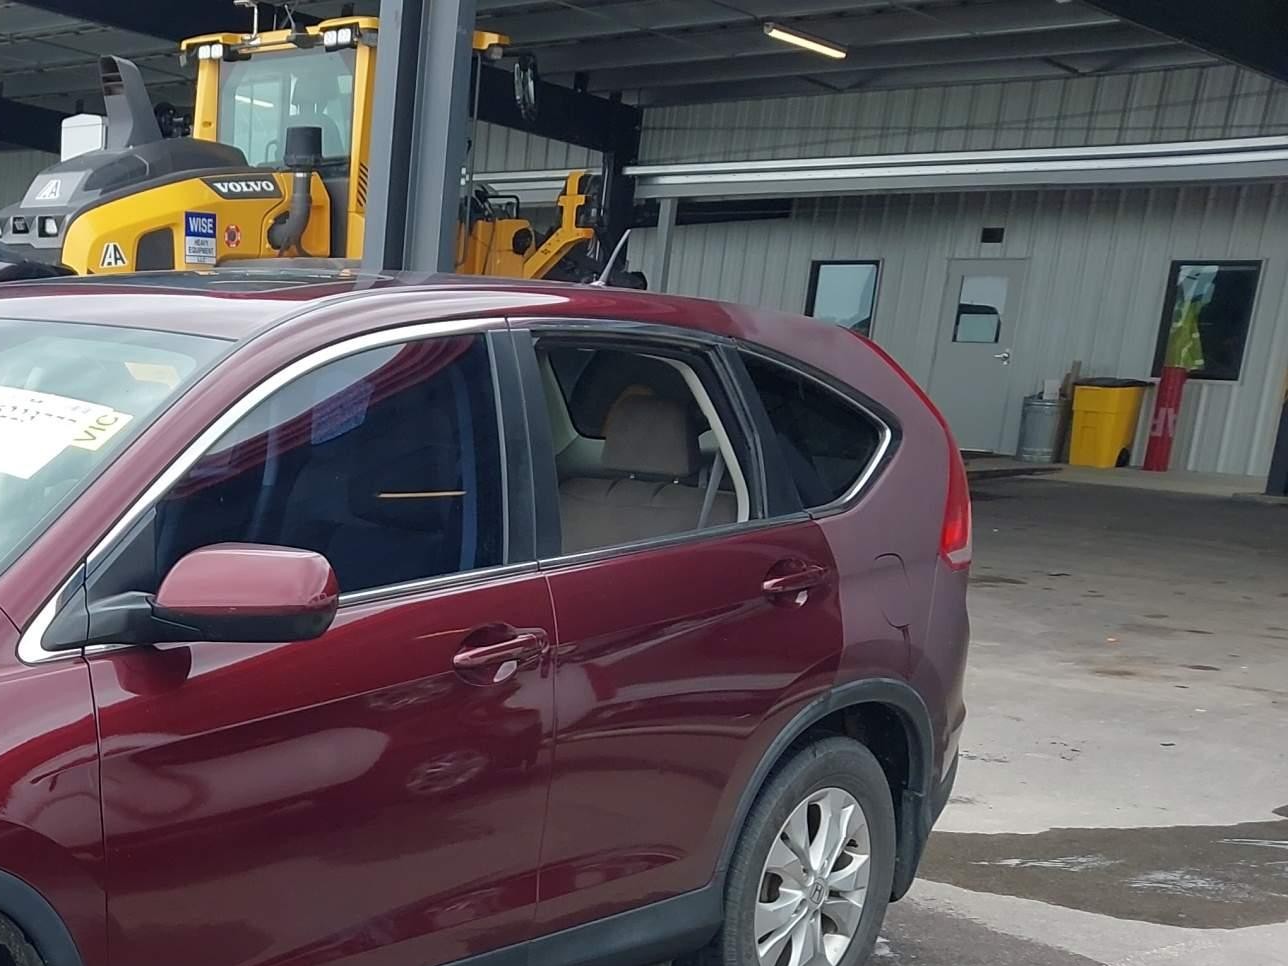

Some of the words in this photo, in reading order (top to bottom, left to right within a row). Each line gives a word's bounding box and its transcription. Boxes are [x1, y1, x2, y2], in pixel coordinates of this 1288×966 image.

[213, 180, 274, 193] VOLVO
[188, 216, 214, 234] WISE
[73, 414, 119, 441] VIC
